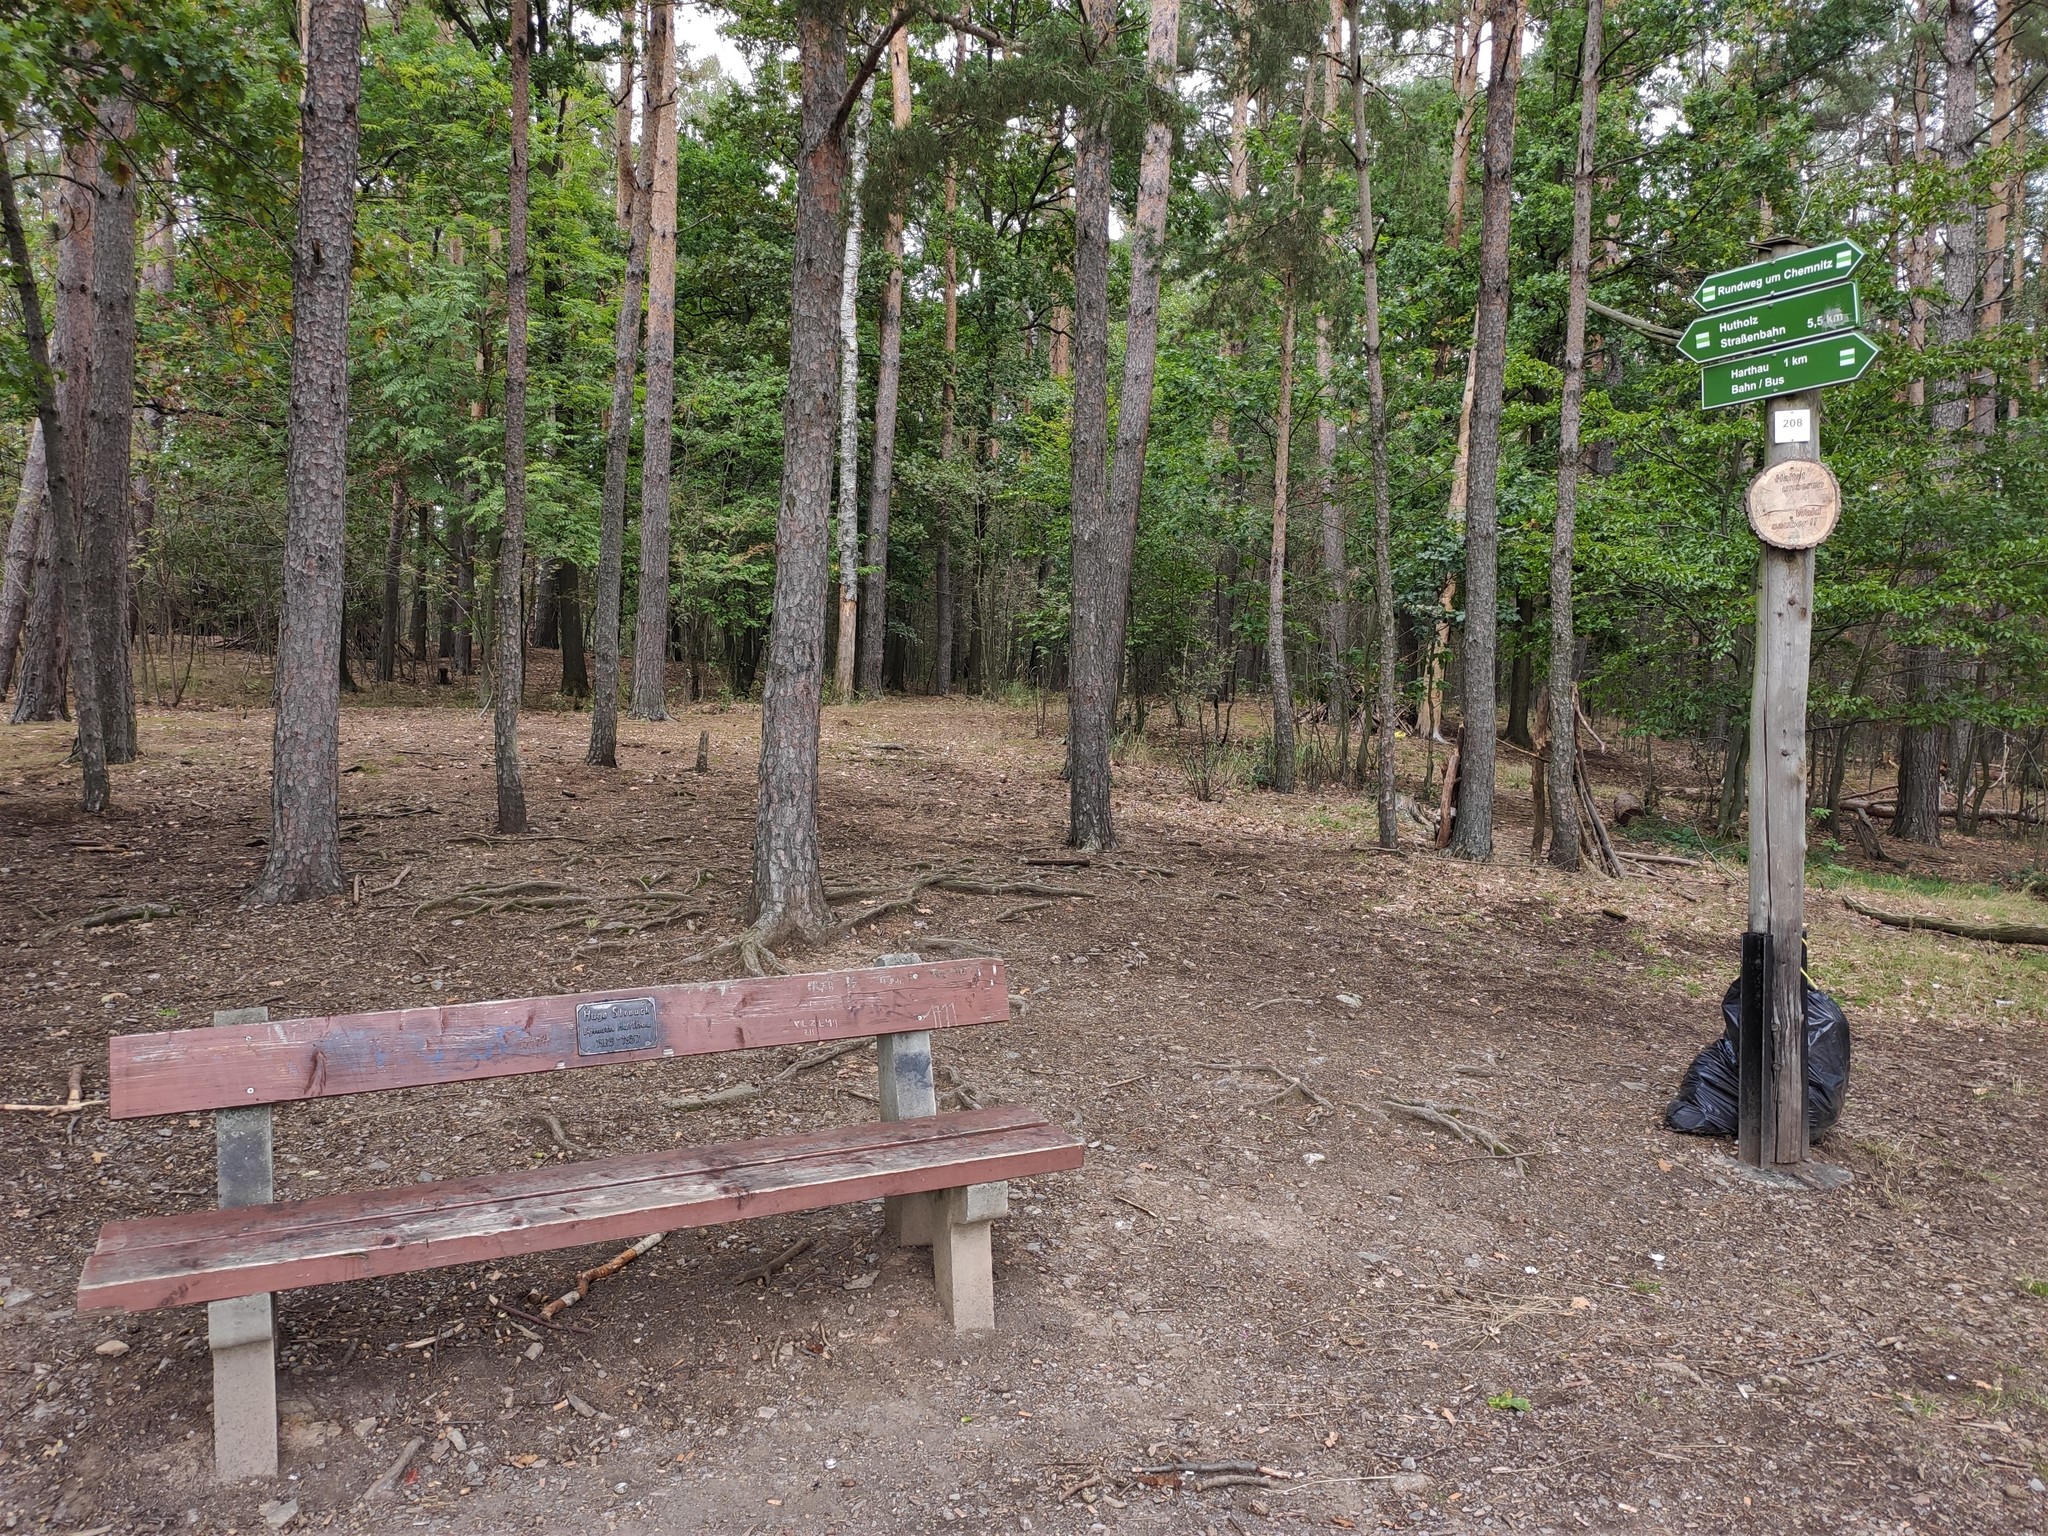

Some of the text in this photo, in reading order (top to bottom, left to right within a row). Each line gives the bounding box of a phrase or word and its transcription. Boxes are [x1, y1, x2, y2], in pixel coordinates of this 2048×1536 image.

[1717, 259, 1833, 296] Rundweg um Chemnitz
[1719, 312, 1844, 333] Hutholz 5,5 km
[1720, 326, 1786, 349] Straßenbahn
[1731, 355, 1808, 379] Harthau 1 km
[1731, 381, 1757, 395] Bahn
[1764, 376, 1785, 388] Bus
[1782, 418, 1803, 428] 208
